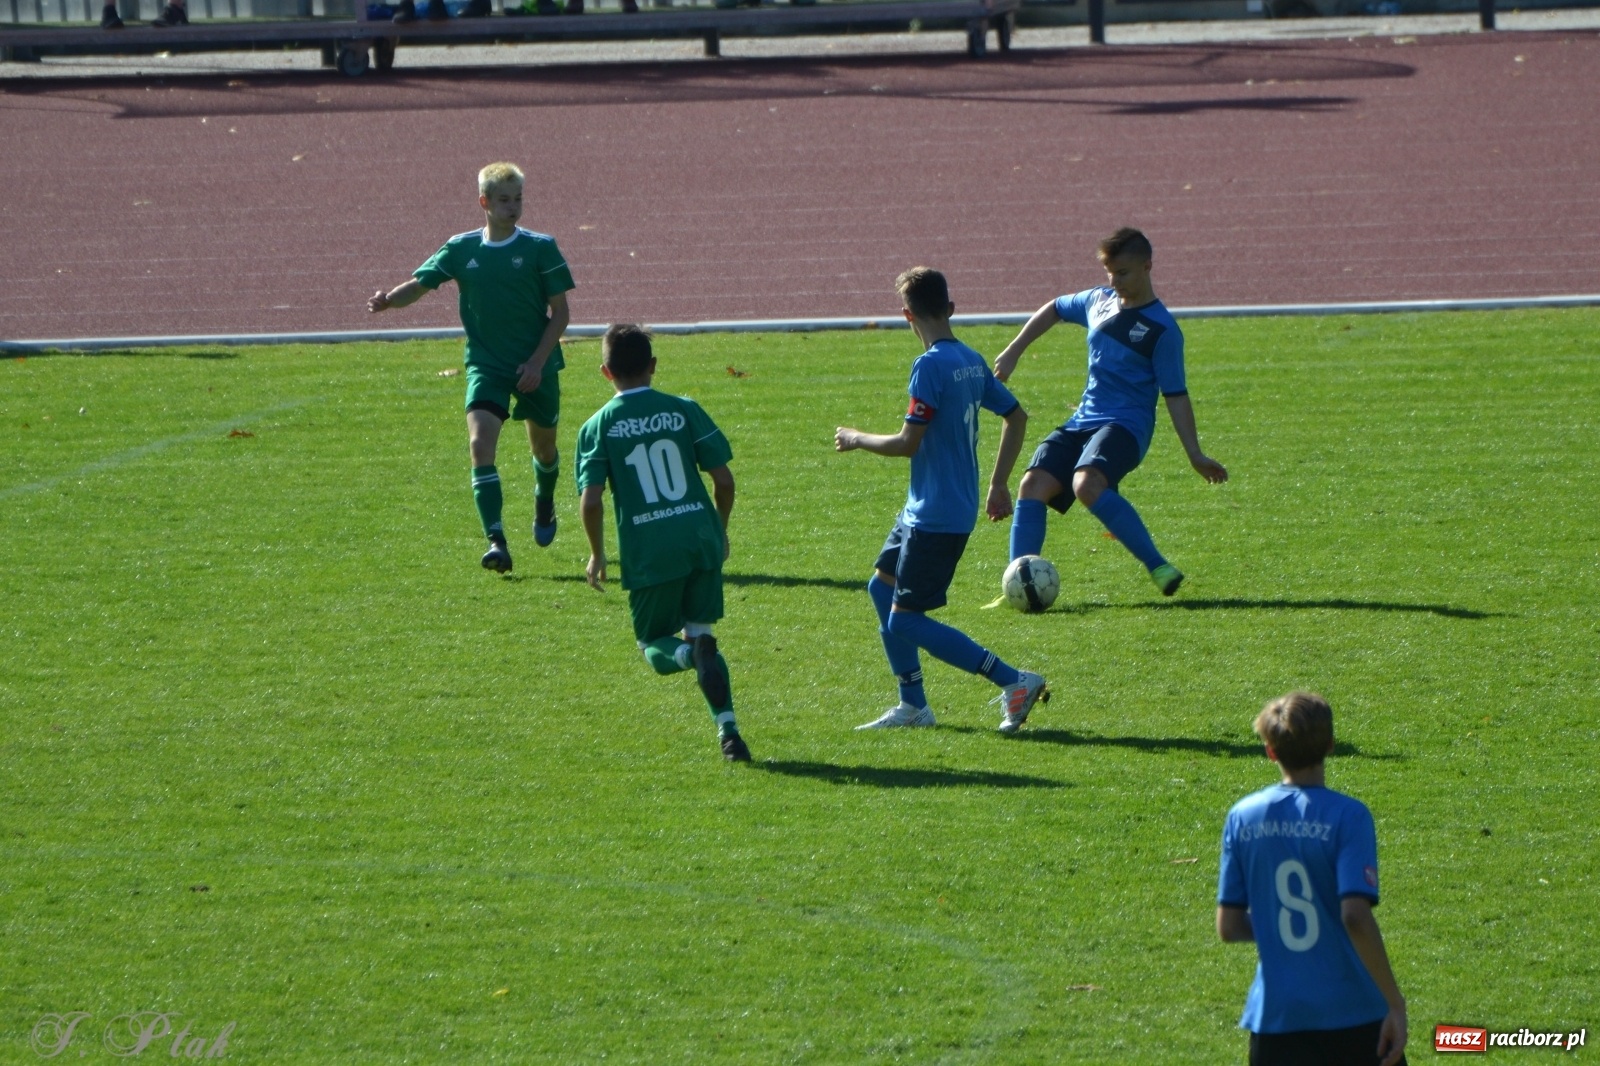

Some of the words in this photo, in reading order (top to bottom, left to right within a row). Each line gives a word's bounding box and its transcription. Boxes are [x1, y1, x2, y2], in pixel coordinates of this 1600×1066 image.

[914, 402, 926, 416] C
[608, 412, 686, 438] REKORD
[963, 400, 981, 468] 1
[624, 438, 688, 504] 10
[632, 501, 704, 525] BIELSKO-BIAŁA
[1239, 827, 1251, 842] KS
[1253, 820, 1280, 839] UNIA
[1275, 859, 1320, 952] 8
